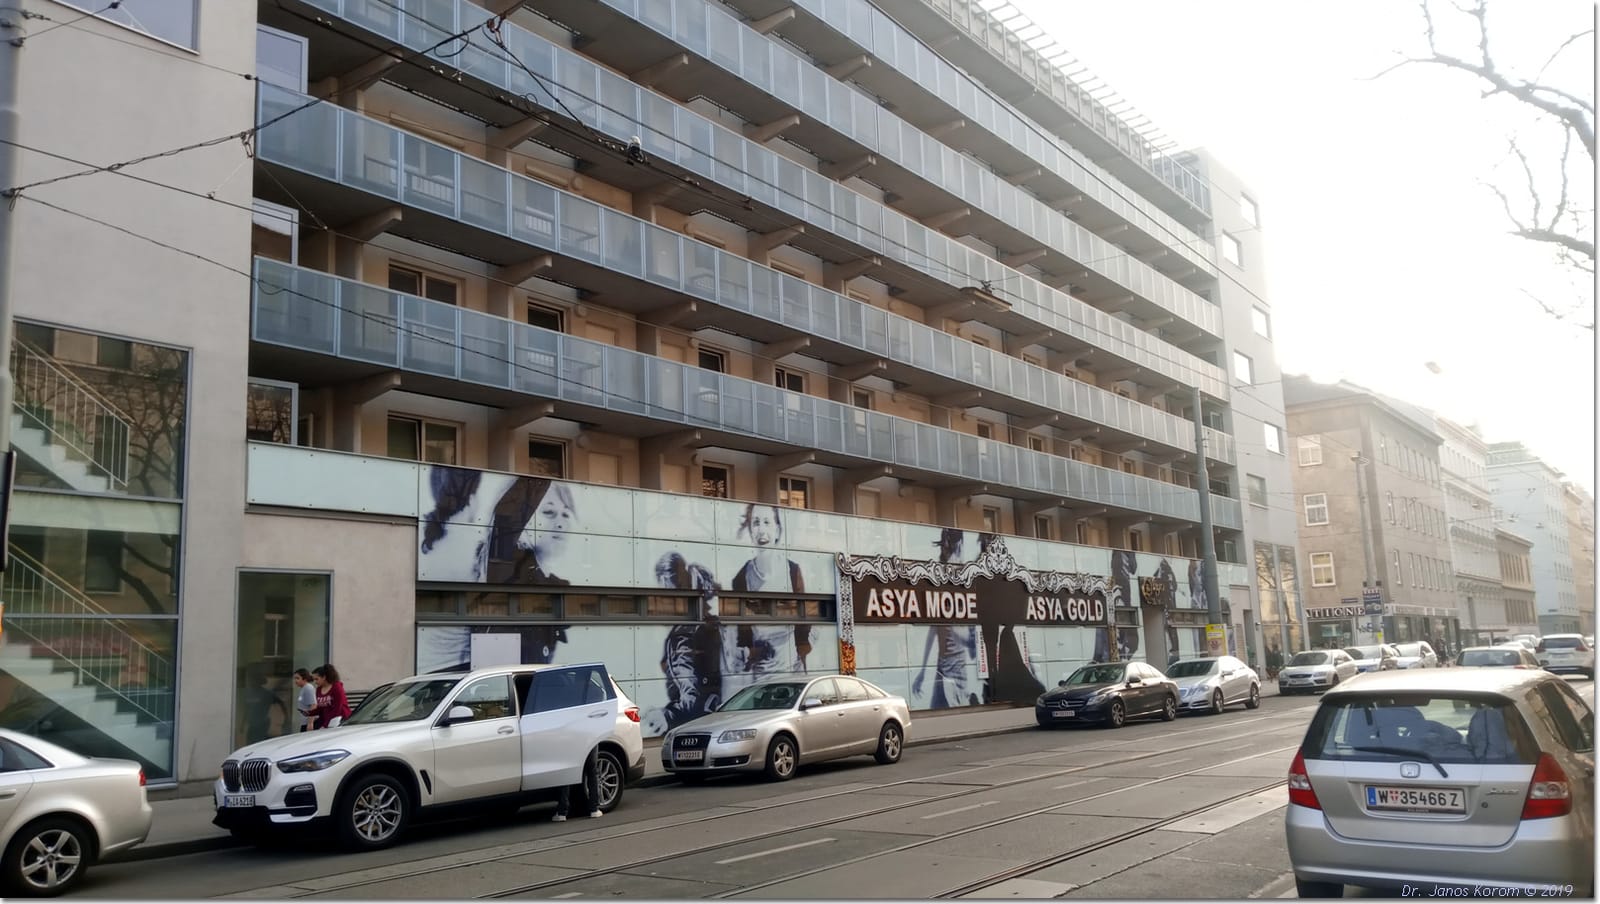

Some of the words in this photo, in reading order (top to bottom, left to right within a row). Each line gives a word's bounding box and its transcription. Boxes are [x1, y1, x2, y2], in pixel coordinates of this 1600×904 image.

[866, 588, 921, 618] ASYA
[926, 592, 978, 620] MODE
[1026, 596, 1065, 621] ASYA
[1067, 598, 1104, 622] GOLD
[1378, 790, 1388, 804] W
